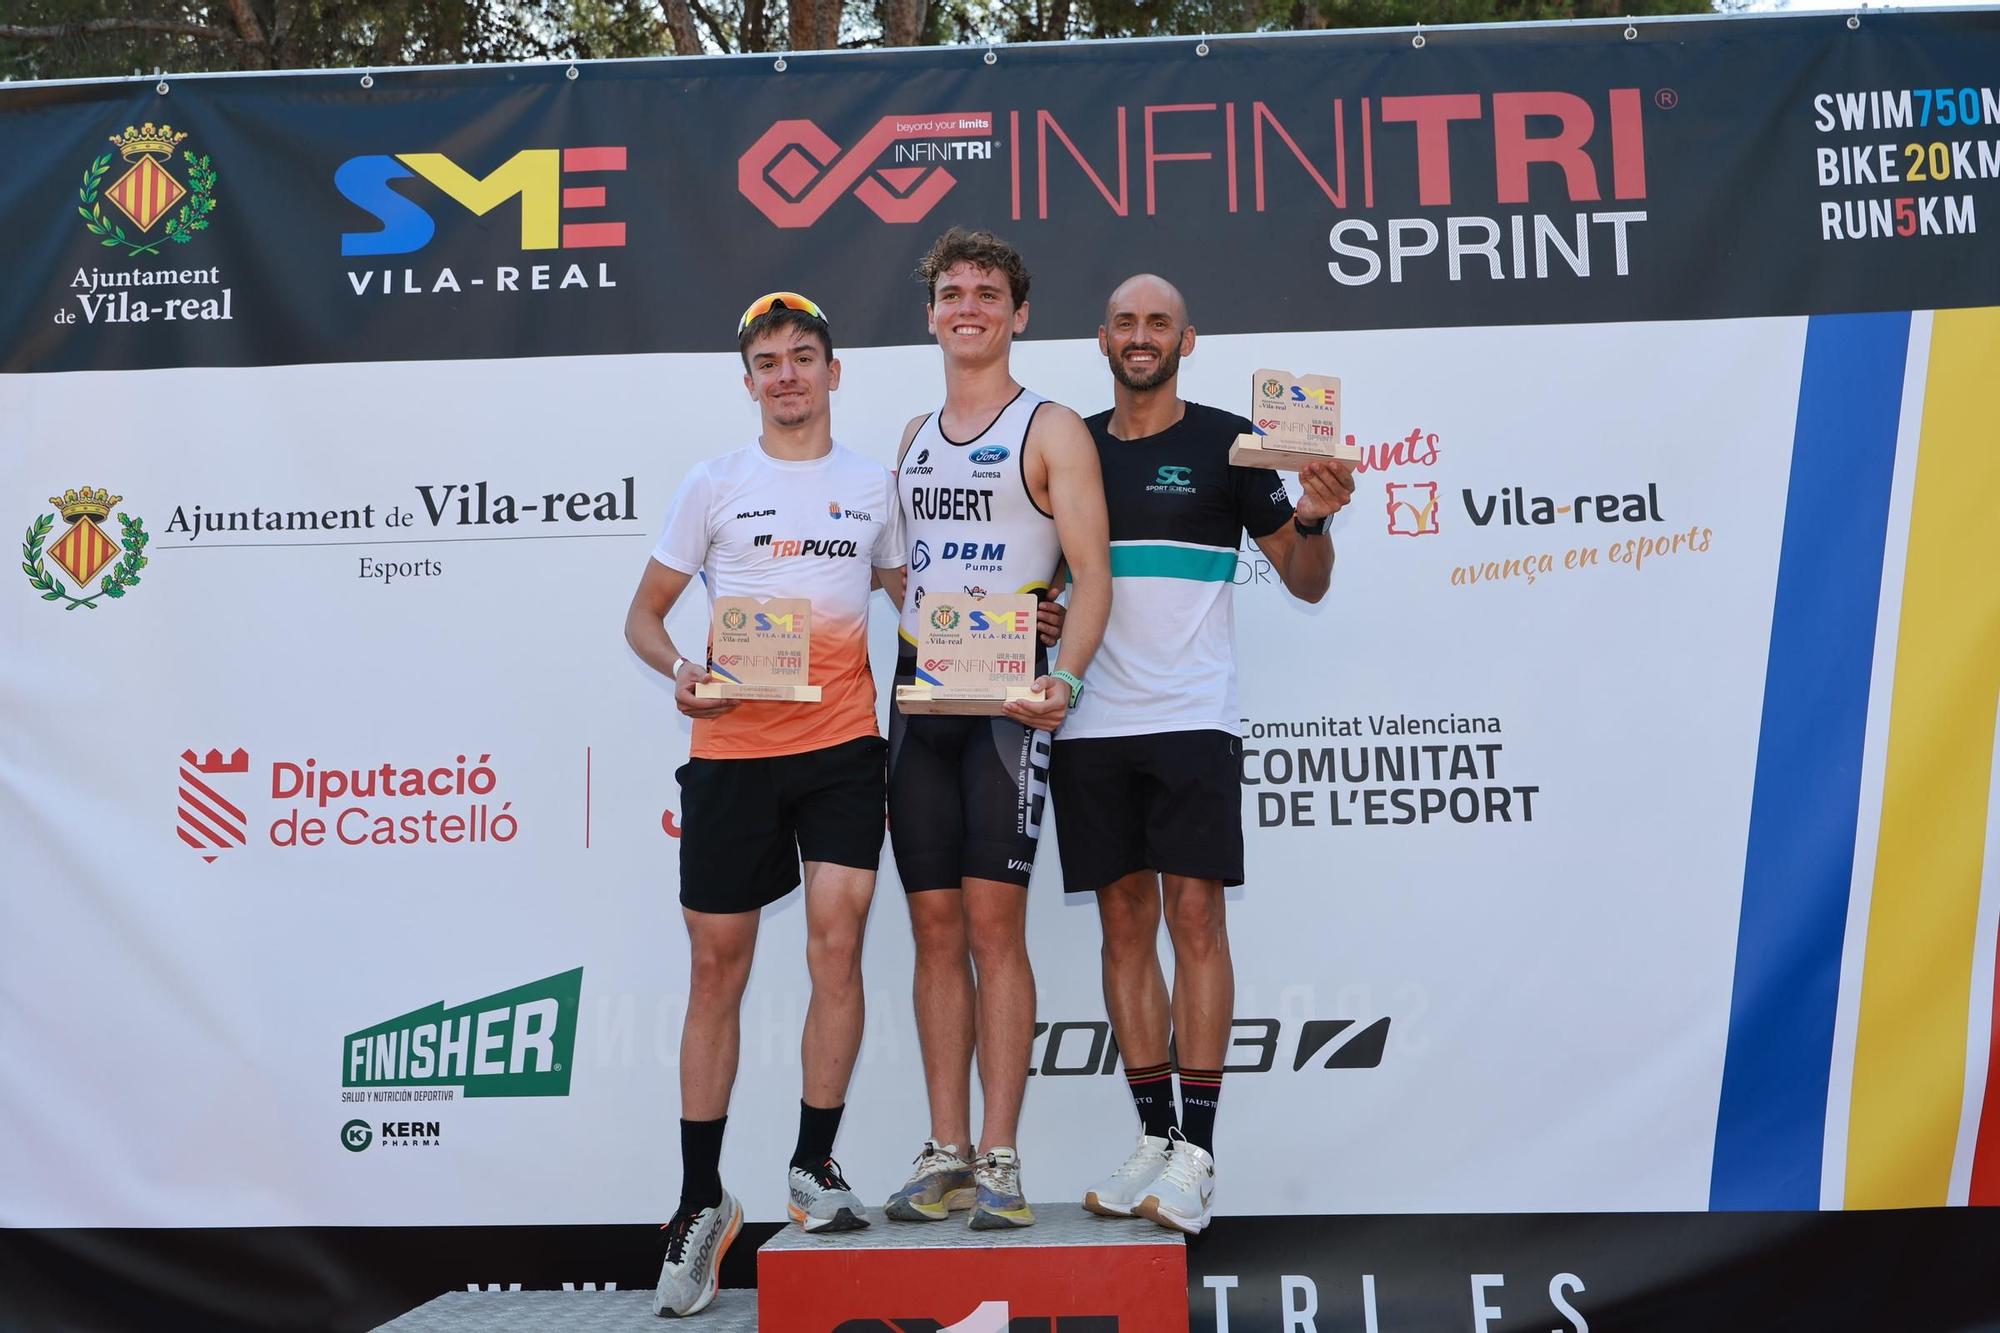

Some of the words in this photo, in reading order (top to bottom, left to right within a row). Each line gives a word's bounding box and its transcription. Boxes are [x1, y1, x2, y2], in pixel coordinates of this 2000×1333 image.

[896, 121, 933, 133] beyond
[935, 121, 956, 131] your
[959, 119, 989, 129] limits
[895, 141, 992, 162] INFINITRI
[1010, 88, 1647, 220] INFINITRI
[334, 146, 628, 256] SME
[1328, 211, 1648, 286] SPRINT
[70, 266, 220, 293] Ajuntament
[347, 263, 617, 296] VILA-REAL
[54, 308, 76, 324] de
[76, 288, 233, 324] Vila-real
[976, 450, 1002, 461] Ford
[1345, 428, 1441, 473] unts
[905, 466, 934, 475] VIATOR
[971, 470, 1001, 479] Aucresa
[164, 504, 376, 541] Ajuntament
[385, 506, 414, 528] de
[415, 476, 639, 527] Vila-real
[736, 509, 776, 519] MUUR
[844, 510, 872, 522] Puçol
[912, 487, 993, 521] RUBERT
[1462, 483, 1666, 526] Vila-real
[771, 539, 857, 559] TRIPUÇOL
[941, 542, 1006, 561] DBM
[1451, 554, 1553, 586] avança
[1564, 546, 1598, 570] en
[1608, 526, 1713, 571] esports
[359, 556, 443, 584] Esports
[965, 562, 1003, 573] Pumps
[969, 610, 1029, 632] SME
[954, 659, 1026, 674] INFINITRI
[1368, 713, 1502, 736] Valenciana
[1240, 744, 1503, 785] COMUNITAT
[271, 754, 497, 807] Diputació
[1257, 791, 1316, 827] DE
[269, 808, 326, 847] de
[336, 802, 518, 847] Castelló
[350, 998, 559, 1082] FINISHER
[342, 1091, 365, 1103] SALUD
[367, 1091, 372, 1102] Y
[374, 1089, 412, 1102] NUTRICIÓN
[414, 1090, 454, 1101] DEPORTIVA
[382, 1121, 440, 1138] KERN
[689, 1214, 723, 1285] BROOKS
